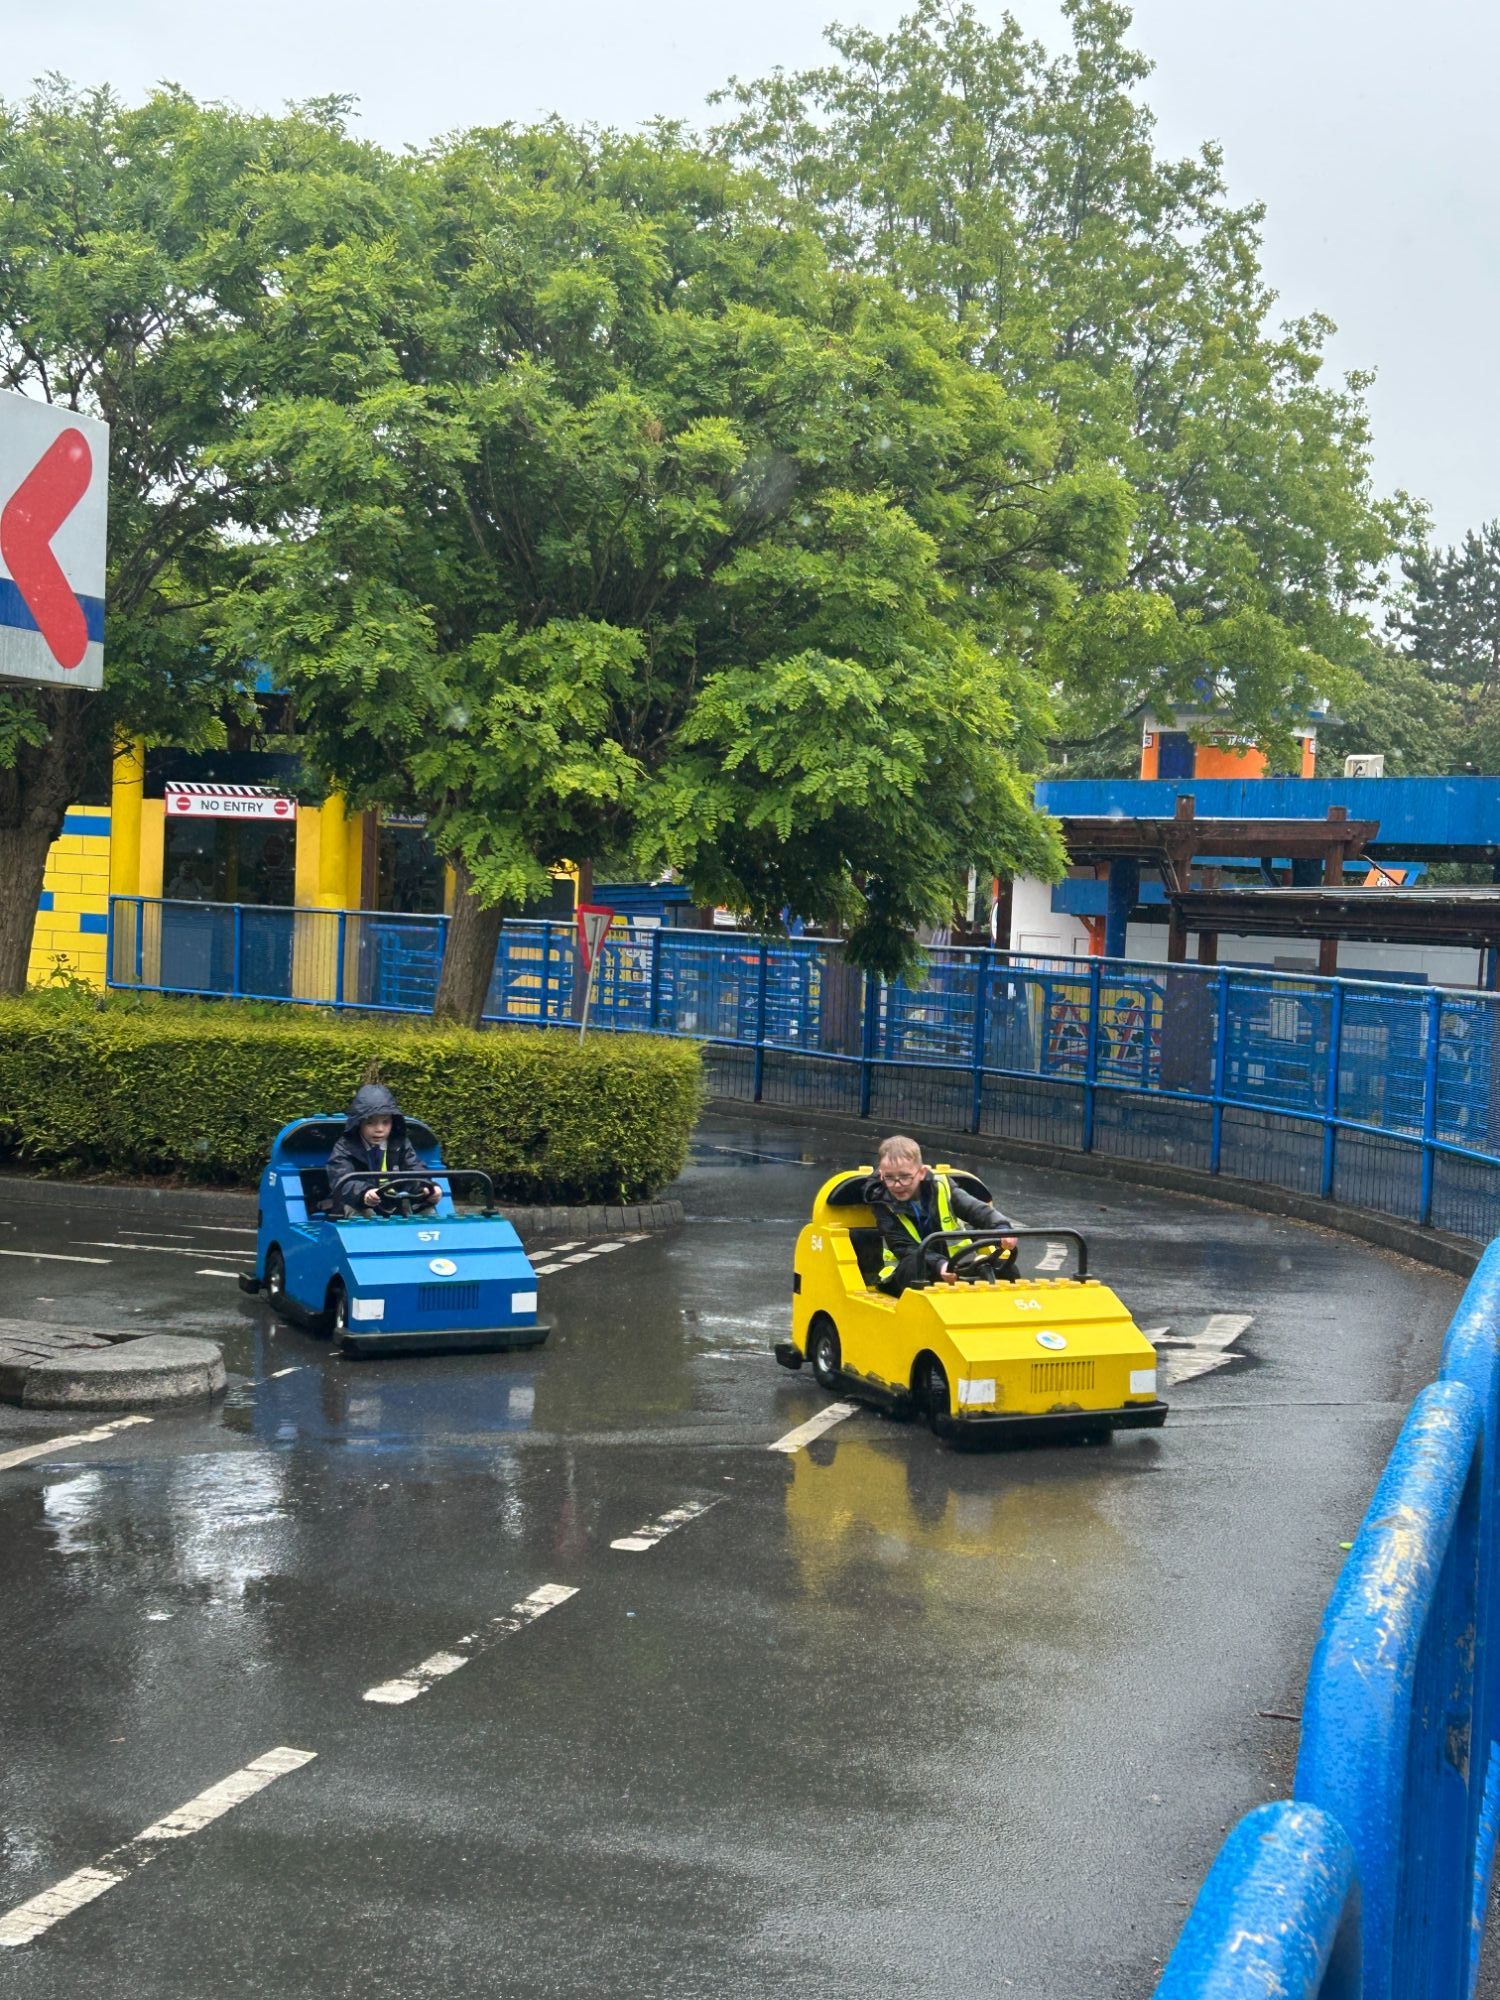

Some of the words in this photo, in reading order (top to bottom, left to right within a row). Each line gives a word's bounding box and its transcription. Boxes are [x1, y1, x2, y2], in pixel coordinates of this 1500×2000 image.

[201, 800, 219, 810] NO
[223, 801, 264, 812] ENTRY
[417, 1231, 440, 1242] 57
[811, 1234, 823, 1252] 54
[1013, 1299, 1041, 1311] 54
